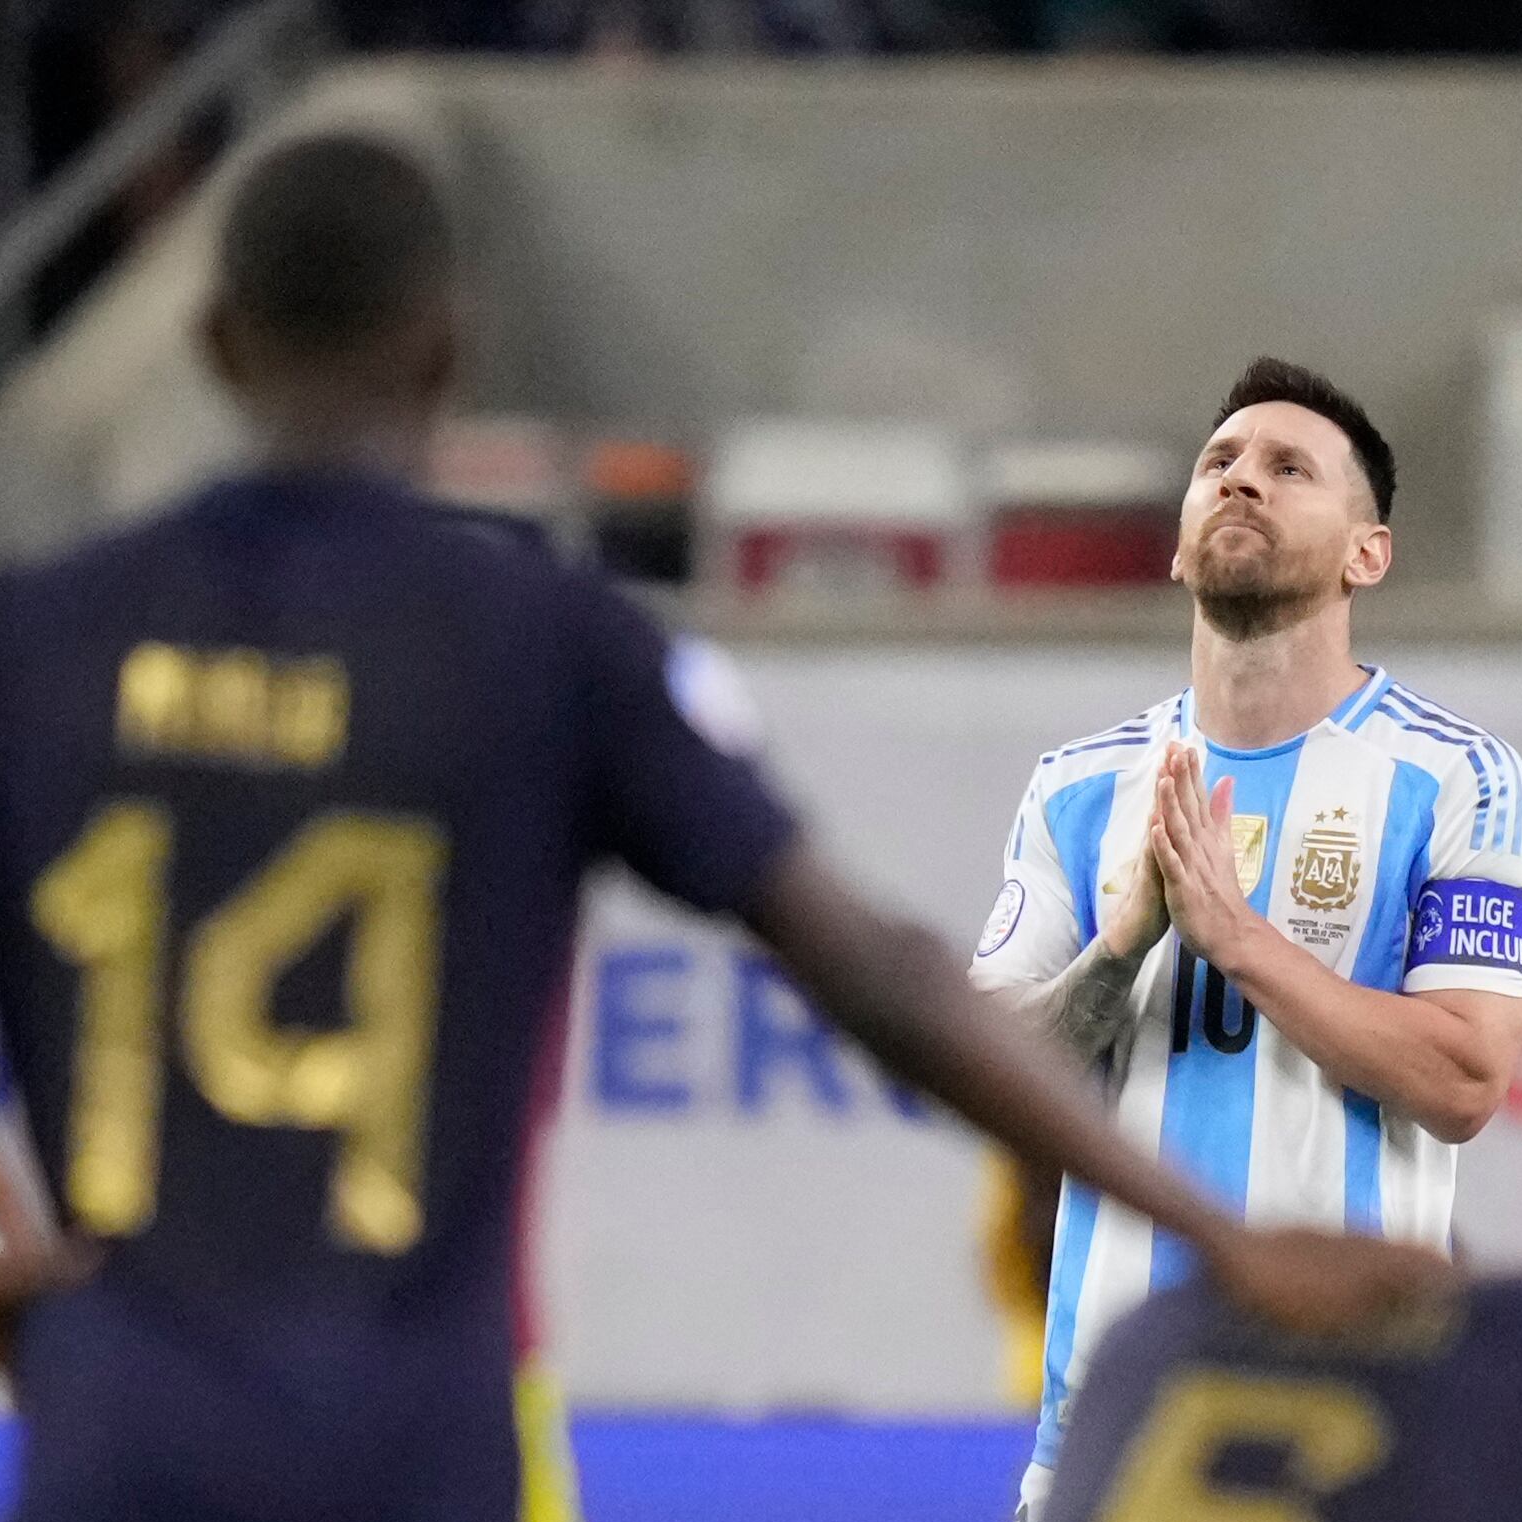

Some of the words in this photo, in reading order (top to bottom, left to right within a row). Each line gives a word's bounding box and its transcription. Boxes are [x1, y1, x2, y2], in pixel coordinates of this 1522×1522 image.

[1305, 849, 1345, 889] AFA
[1451, 894, 1515, 929] ELIGE
[31, 801, 449, 1253] 14
